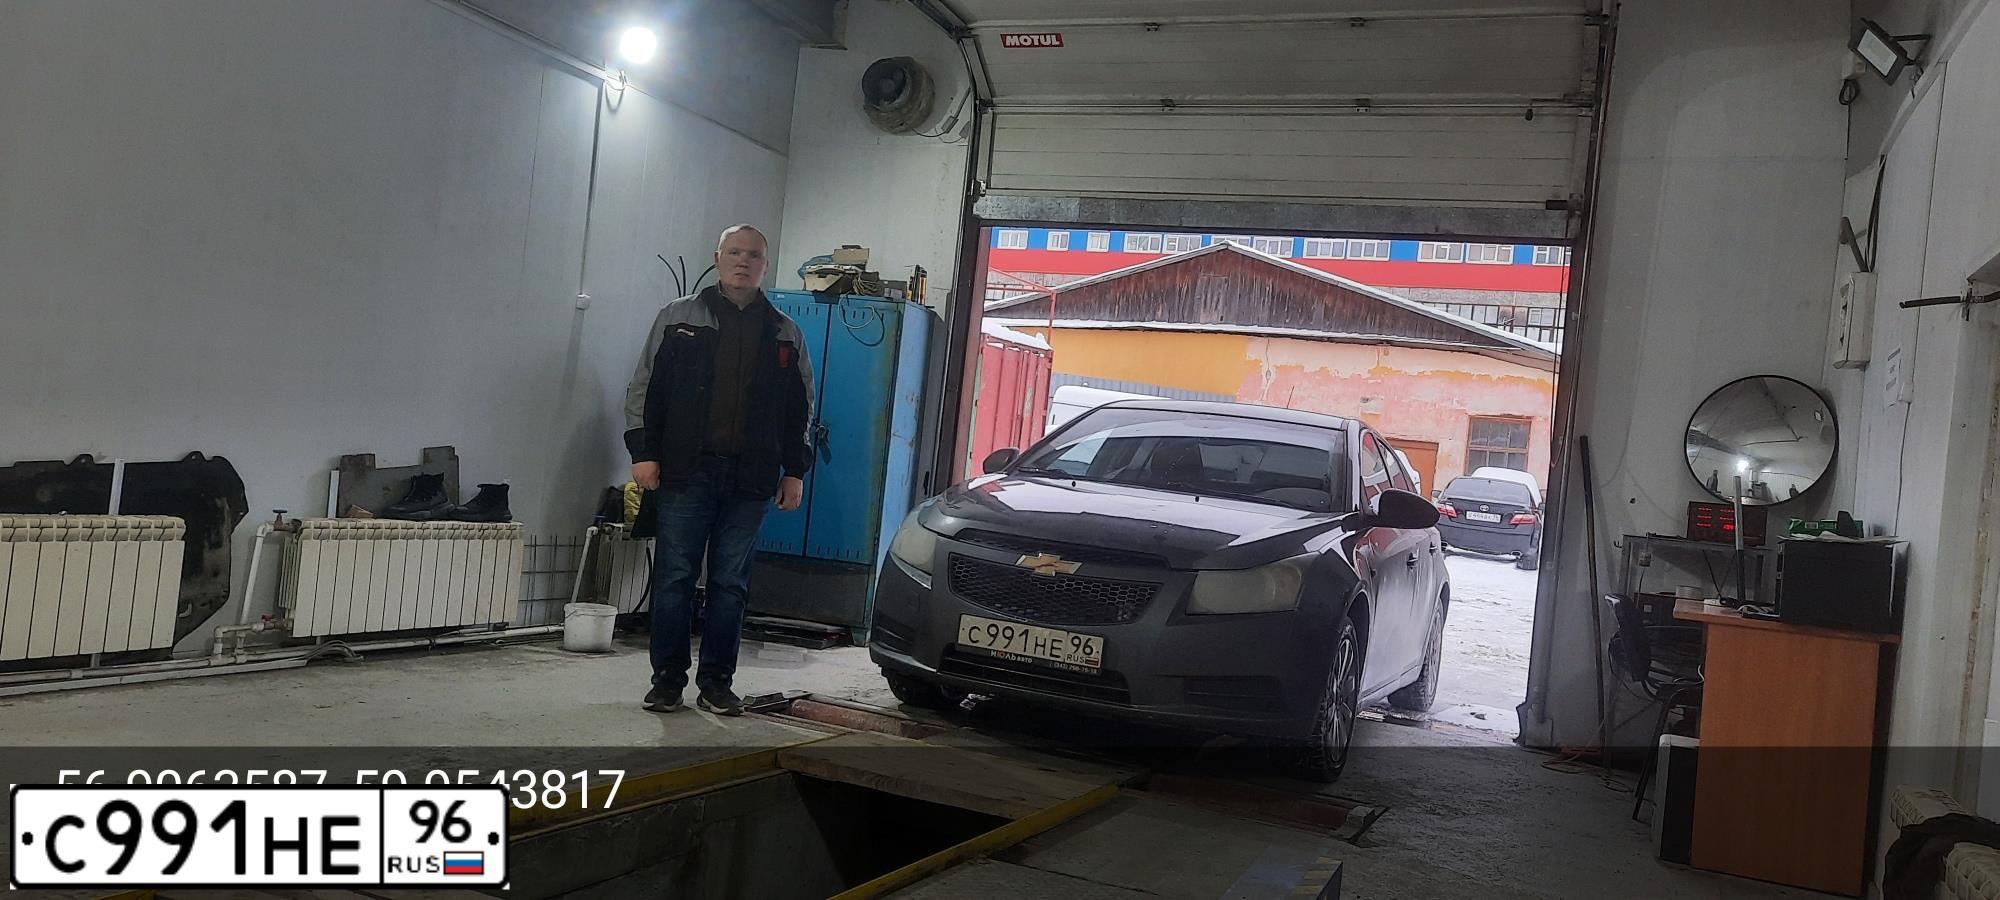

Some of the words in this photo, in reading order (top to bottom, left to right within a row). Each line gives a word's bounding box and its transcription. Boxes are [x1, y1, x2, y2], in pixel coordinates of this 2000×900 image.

[1005, 35, 1060, 46] MOTUL
[1071, 636, 1094, 656] 96
[1066, 654, 1085, 664] RUS
